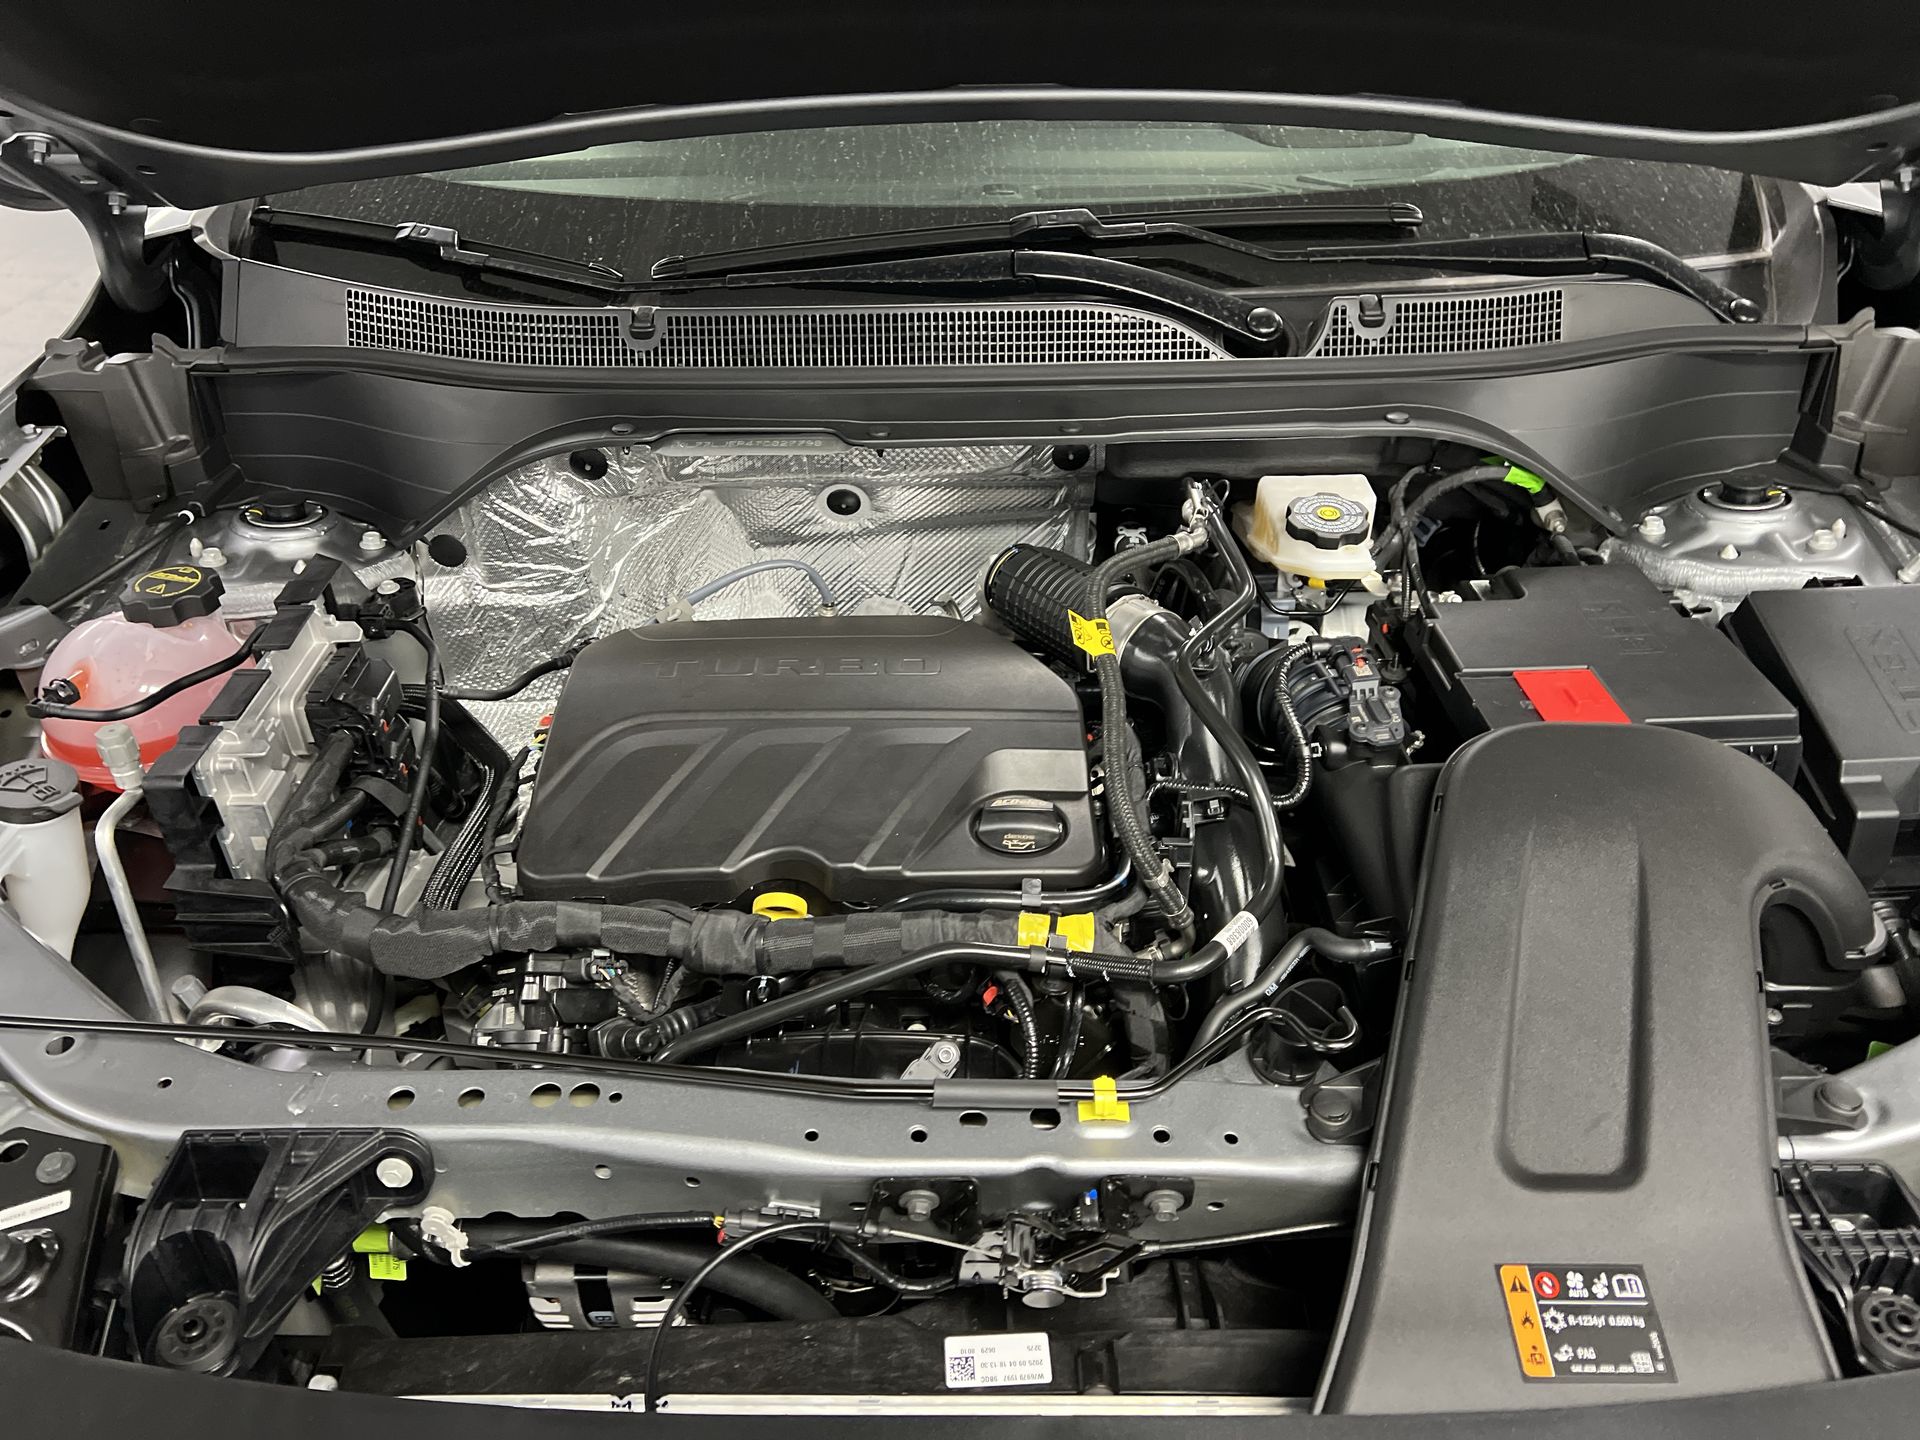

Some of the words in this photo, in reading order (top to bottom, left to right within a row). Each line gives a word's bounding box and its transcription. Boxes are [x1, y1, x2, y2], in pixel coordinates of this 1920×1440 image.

[642, 656, 941, 679] TURBO
[1568, 1288, 1589, 1298] AUTO
[1633, 1315, 1646, 1329] kg
[1576, 1346, 1597, 1360] PAG
